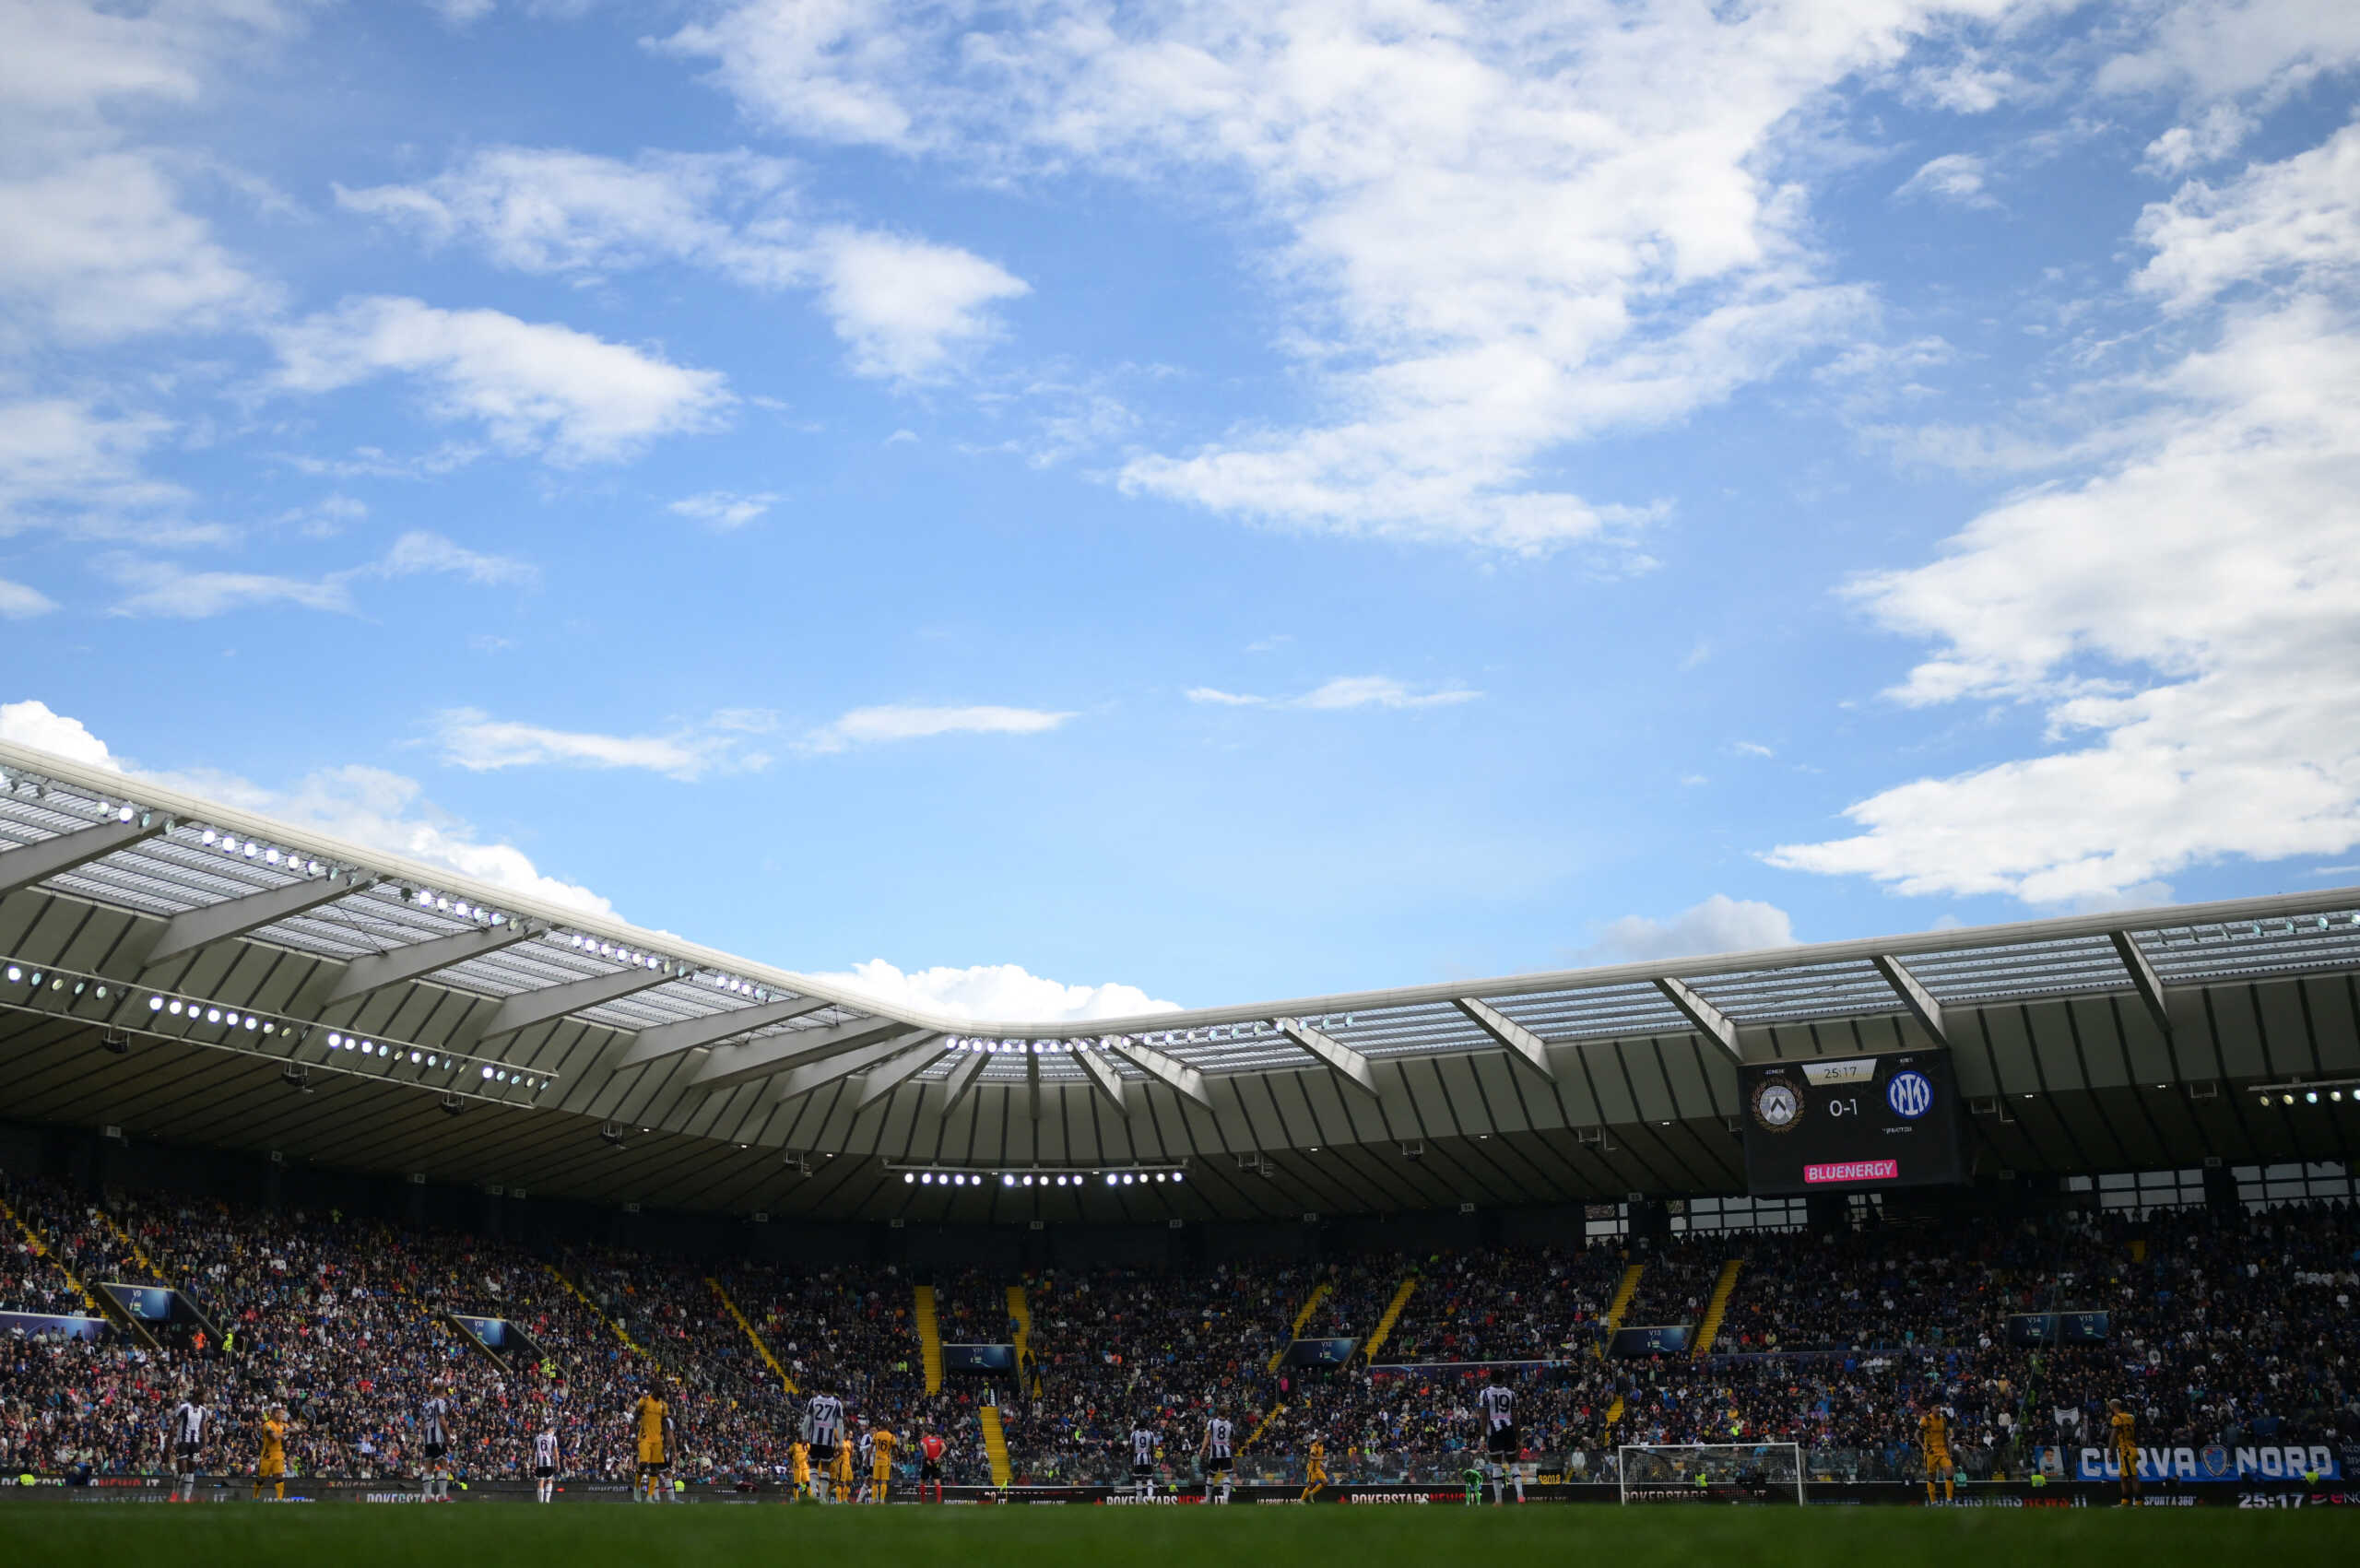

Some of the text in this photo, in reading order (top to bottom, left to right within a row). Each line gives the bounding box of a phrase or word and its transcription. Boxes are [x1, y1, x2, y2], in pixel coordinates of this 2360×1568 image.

[1824, 1067, 1858, 1079] 25:17
[1829, 1098, 1858, 1117] 0-1
[1808, 1161, 1894, 1181] BLUENERGY
[1493, 1394, 1510, 1413] 19
[815, 1403, 834, 1421] 27
[1218, 1425, 1226, 1440] 8
[540, 1439, 548, 1451] 6
[877, 1438, 888, 1451] 16
[1139, 1436, 1147, 1448] 9
[2081, 1446, 2197, 1477] CURVA
[2235, 1444, 2333, 1477] NORD
[2235, 1493, 2305, 1509] 25:17
